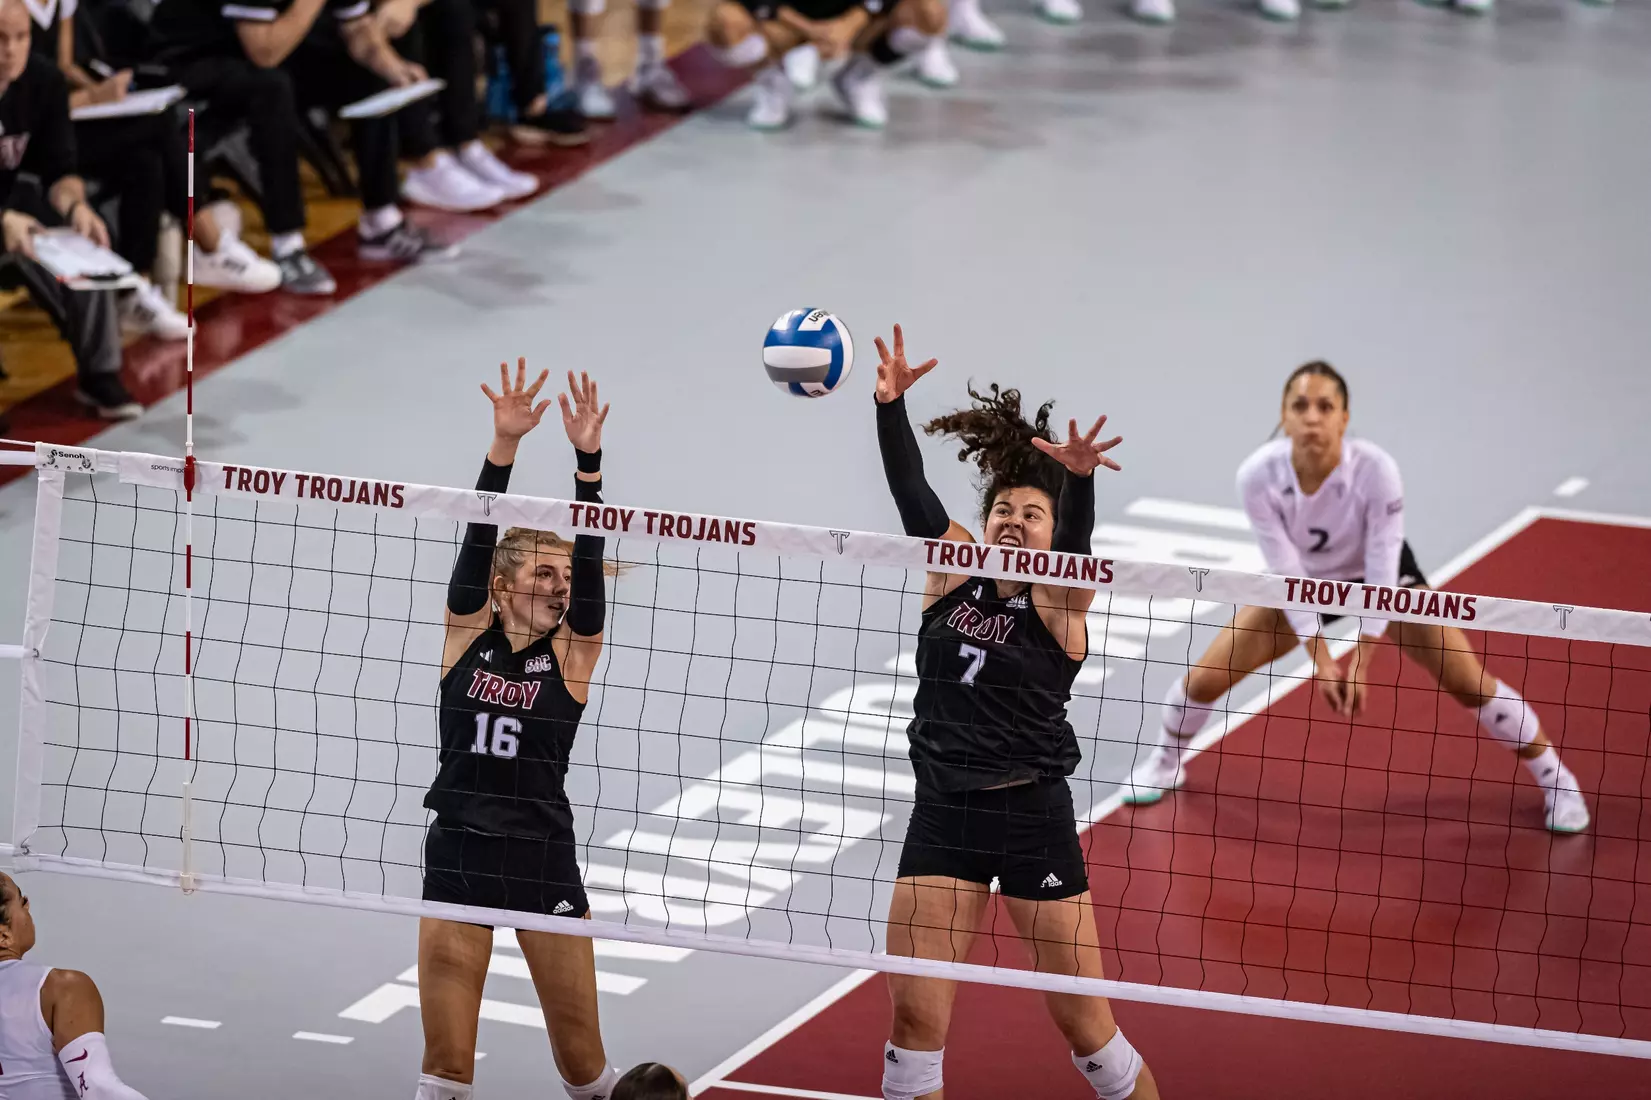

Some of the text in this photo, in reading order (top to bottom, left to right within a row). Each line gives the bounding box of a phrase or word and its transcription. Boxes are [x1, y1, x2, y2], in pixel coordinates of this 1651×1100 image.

[58, 451, 85, 459] Senoh
[222, 466, 405, 509] TROY TROJANS
[569, 504, 757, 546] TROY TROJANS
[1308, 528, 1331, 553] 2
[924, 541, 1114, 583] TROY TROJANS
[1284, 577, 1477, 621] TROY TROJANS
[947, 601, 1015, 643] TROY
[958, 643, 987, 687] 7
[467, 668, 541, 709] TROY
[470, 712, 523, 759] 16
